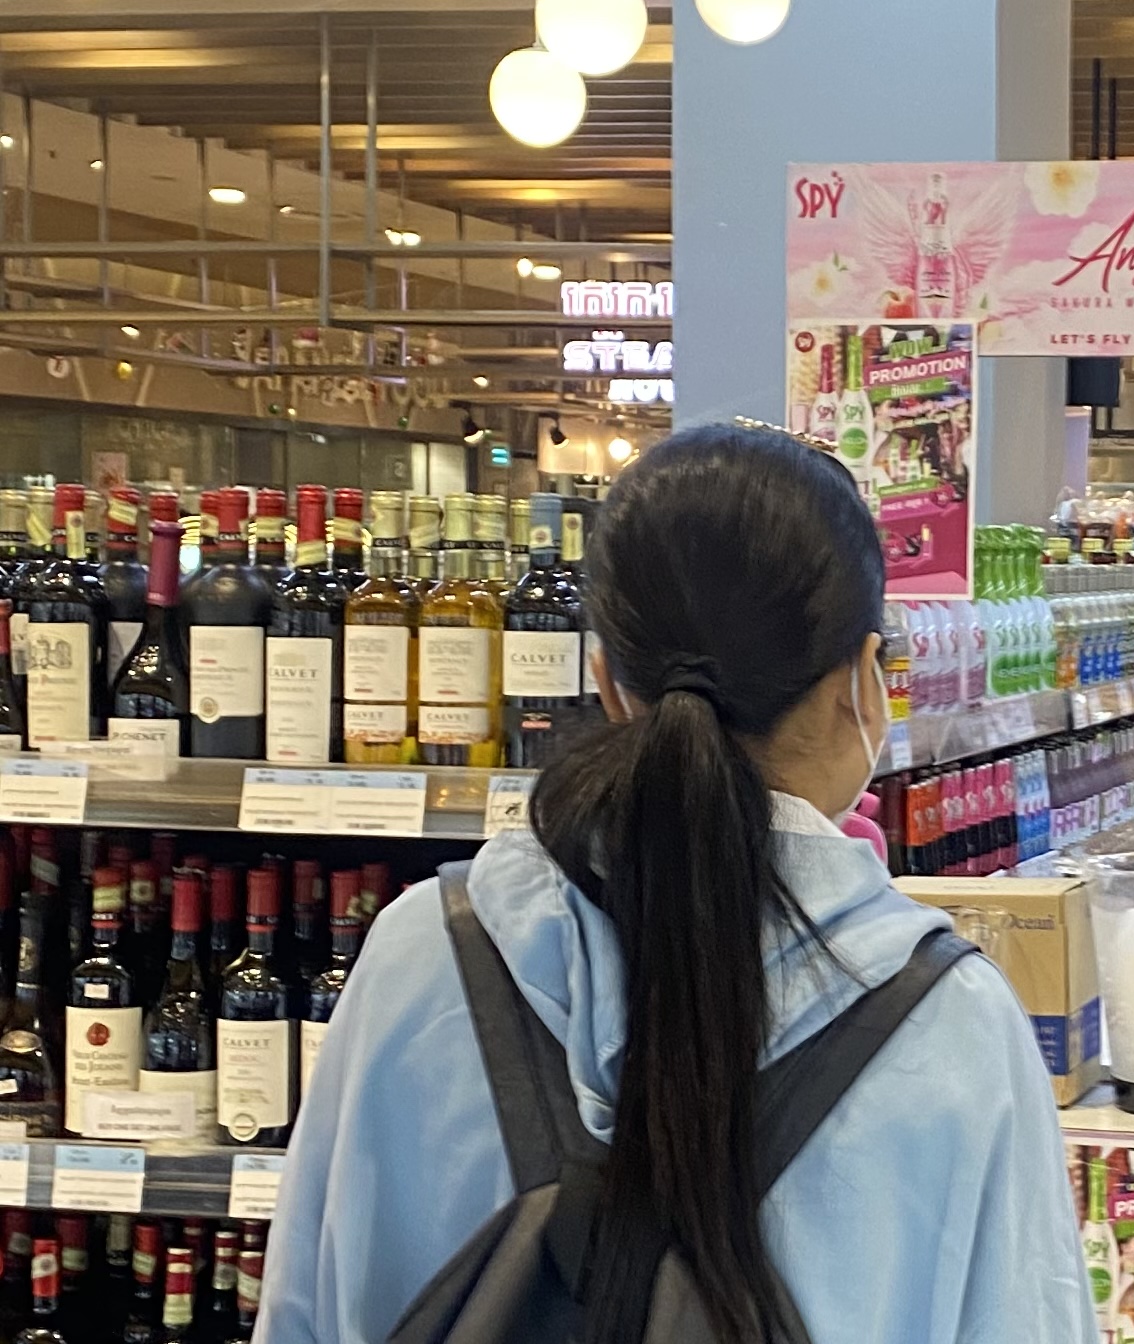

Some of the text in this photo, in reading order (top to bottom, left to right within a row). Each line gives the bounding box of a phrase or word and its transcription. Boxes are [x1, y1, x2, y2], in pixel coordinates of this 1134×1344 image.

[795, 171, 845, 218] SPY
[1050, 334, 1096, 345] LET'S
[1102, 334, 1131, 345] FLY
[563, 341, 673, 371] STEA
[868, 355, 968, 385] PROMOTION
[511, 653, 567, 664] CALVET
